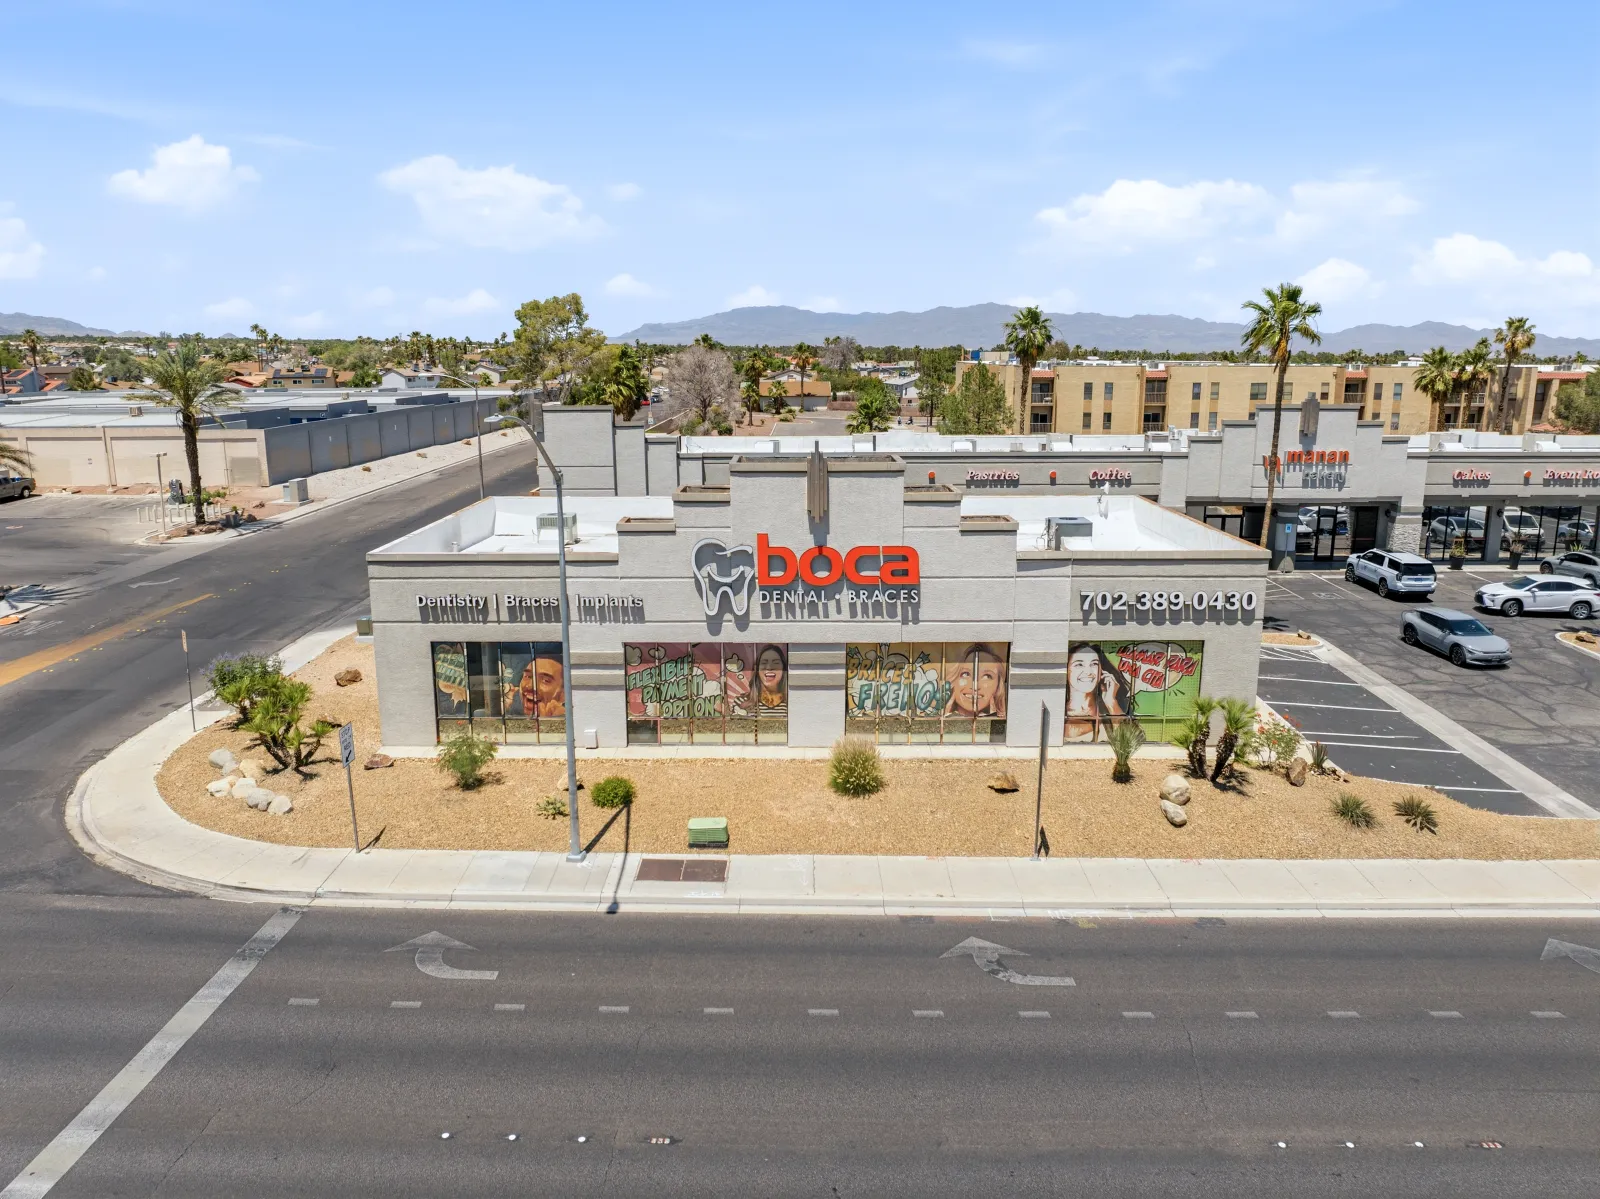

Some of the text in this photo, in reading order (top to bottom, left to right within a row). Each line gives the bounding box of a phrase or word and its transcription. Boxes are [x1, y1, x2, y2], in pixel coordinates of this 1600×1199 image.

[1286, 449, 1350, 464] manan
[966, 468, 1020, 481] Pastries
[1089, 467, 1133, 481] Coffee
[1453, 468, 1492, 480] Cakes
[1543, 469, 1580, 480] Event
[757, 533, 920, 586] boca
[415, 594, 643, 609] Dentistry Braces Implants
[759, 590, 919, 604] DENTAL BRACES
[1080, 590, 1257, 610] 702-389-0430
